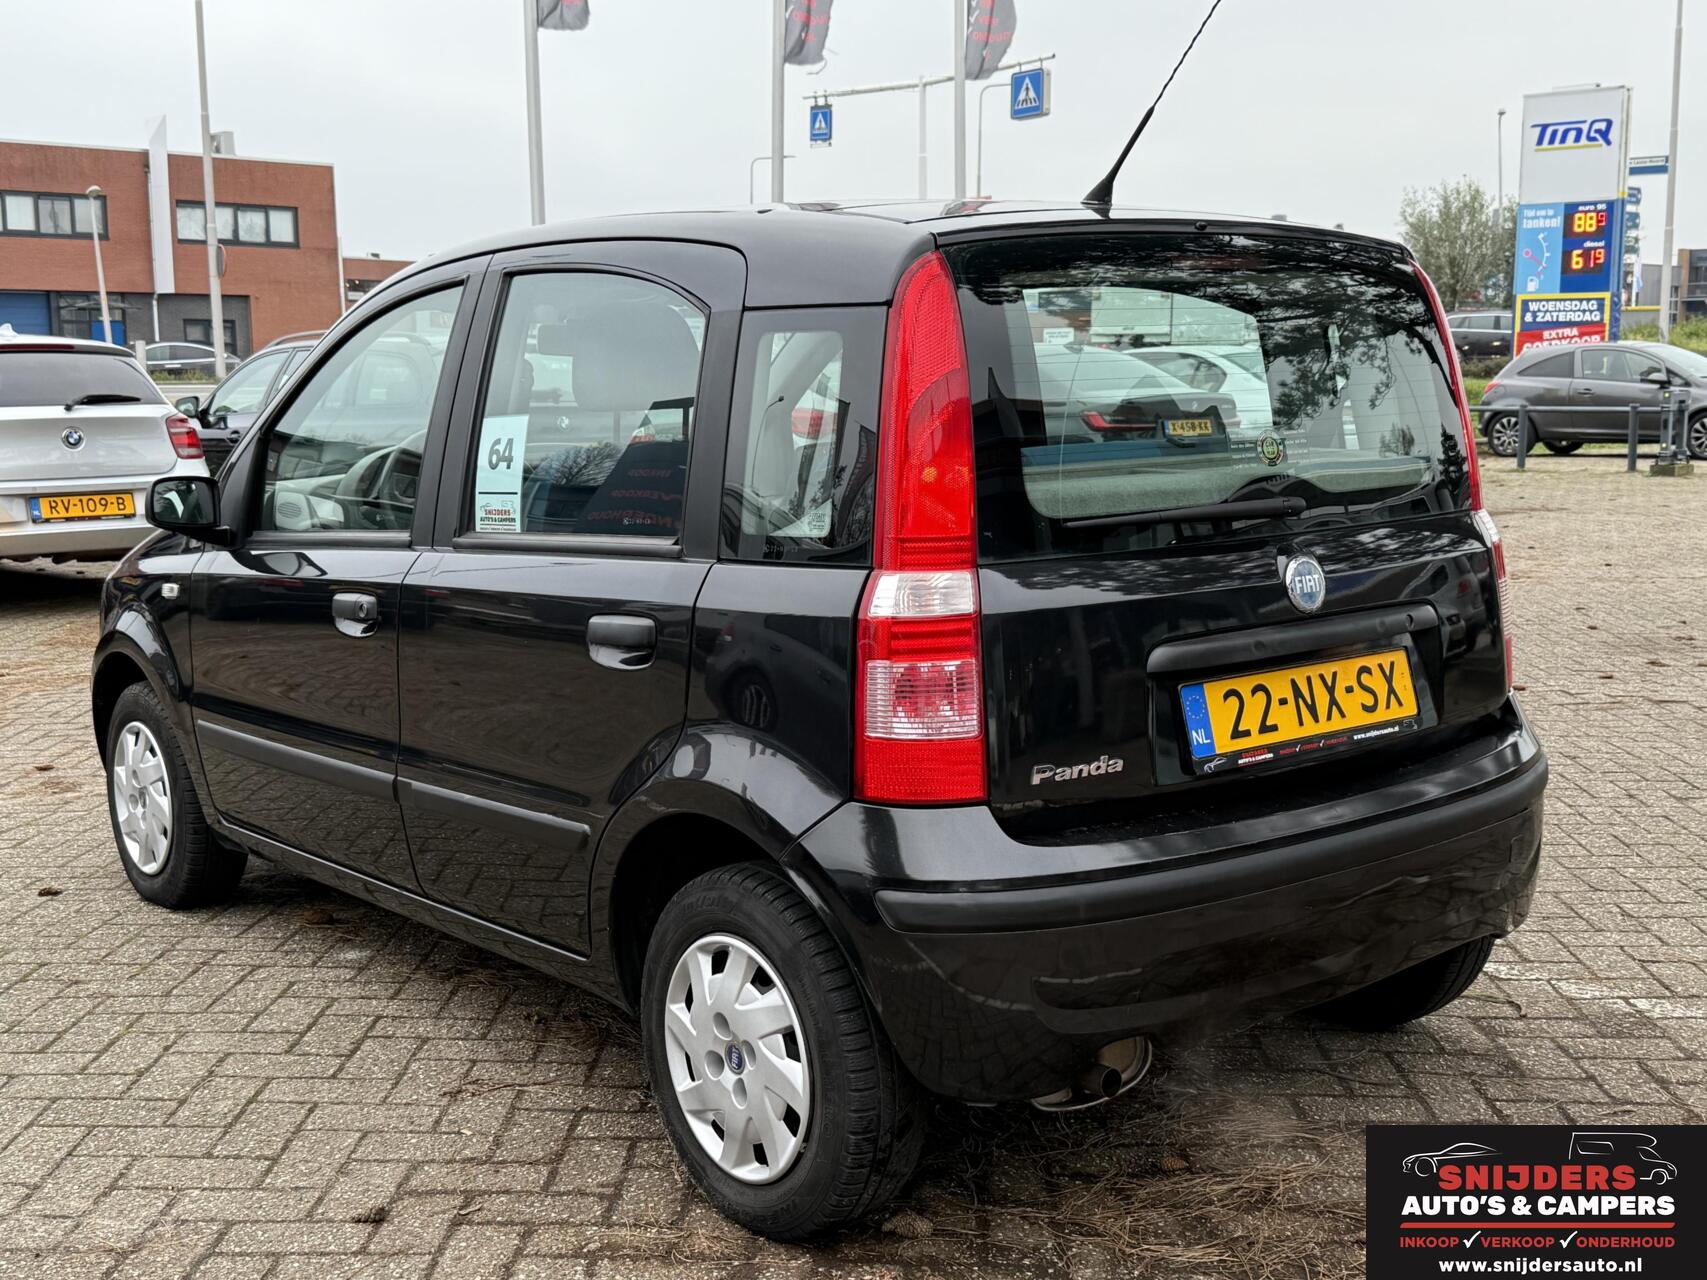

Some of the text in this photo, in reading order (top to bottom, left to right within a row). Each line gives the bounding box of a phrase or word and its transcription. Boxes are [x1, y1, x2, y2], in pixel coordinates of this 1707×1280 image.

[1523, 216, 1560, 228] tanken!
[1528, 301, 1598, 311] WOENSDAG
[1524, 311, 1601, 322] & ZATERDAG
[1542, 327, 1579, 339] EXTRA
[488, 438, 514, 470] 64
[48, 496, 126, 515] RV-109-B
[1295, 575, 1320, 593] FIAT
[1222, 661, 1404, 740] 22-NX-SX
[1192, 729, 1211, 746] NL
[1031, 755, 1124, 785] Panda
[731, 1047, 741, 1069] FIAT
